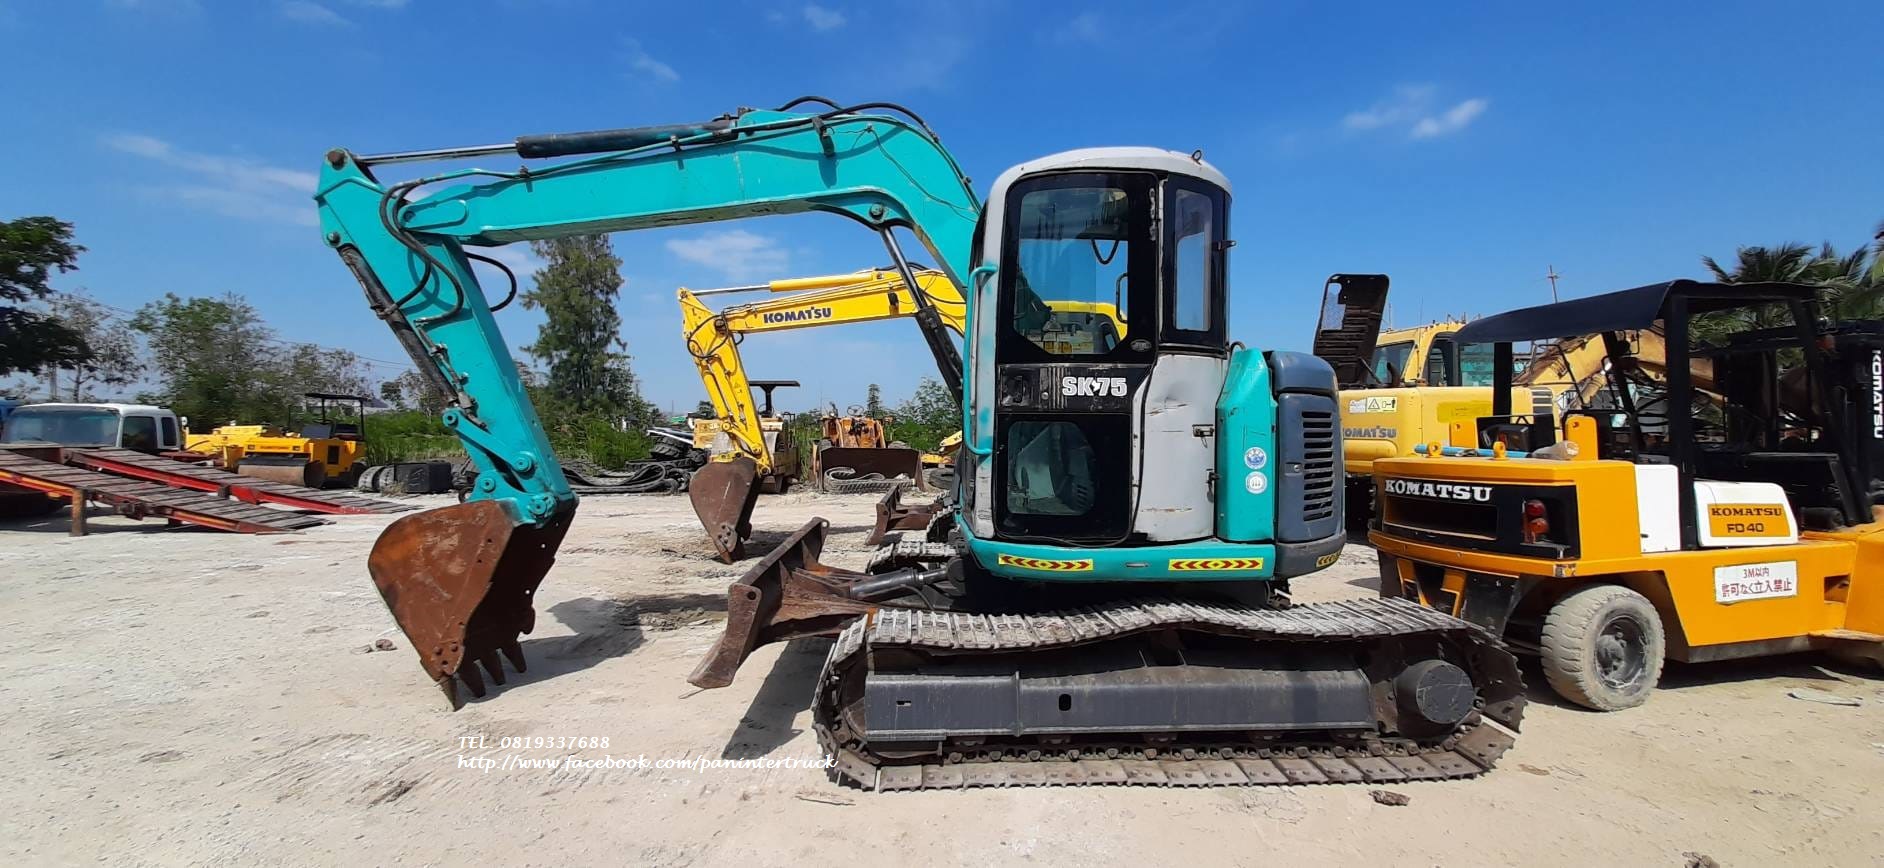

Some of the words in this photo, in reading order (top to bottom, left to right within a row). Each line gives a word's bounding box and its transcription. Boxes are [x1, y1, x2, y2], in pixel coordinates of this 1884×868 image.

[763, 306, 832, 323] KOMATSU
[1872, 349, 1884, 439] KOMATSU
[1343, 425, 1397, 438] OMATSU
[1385, 479, 1493, 501] KOMATSU
[1711, 507, 1782, 517] KOMATSU
[1743, 567, 1770, 579] 3M以内
[1721, 578, 1793, 598] 許可なく立入禁止
